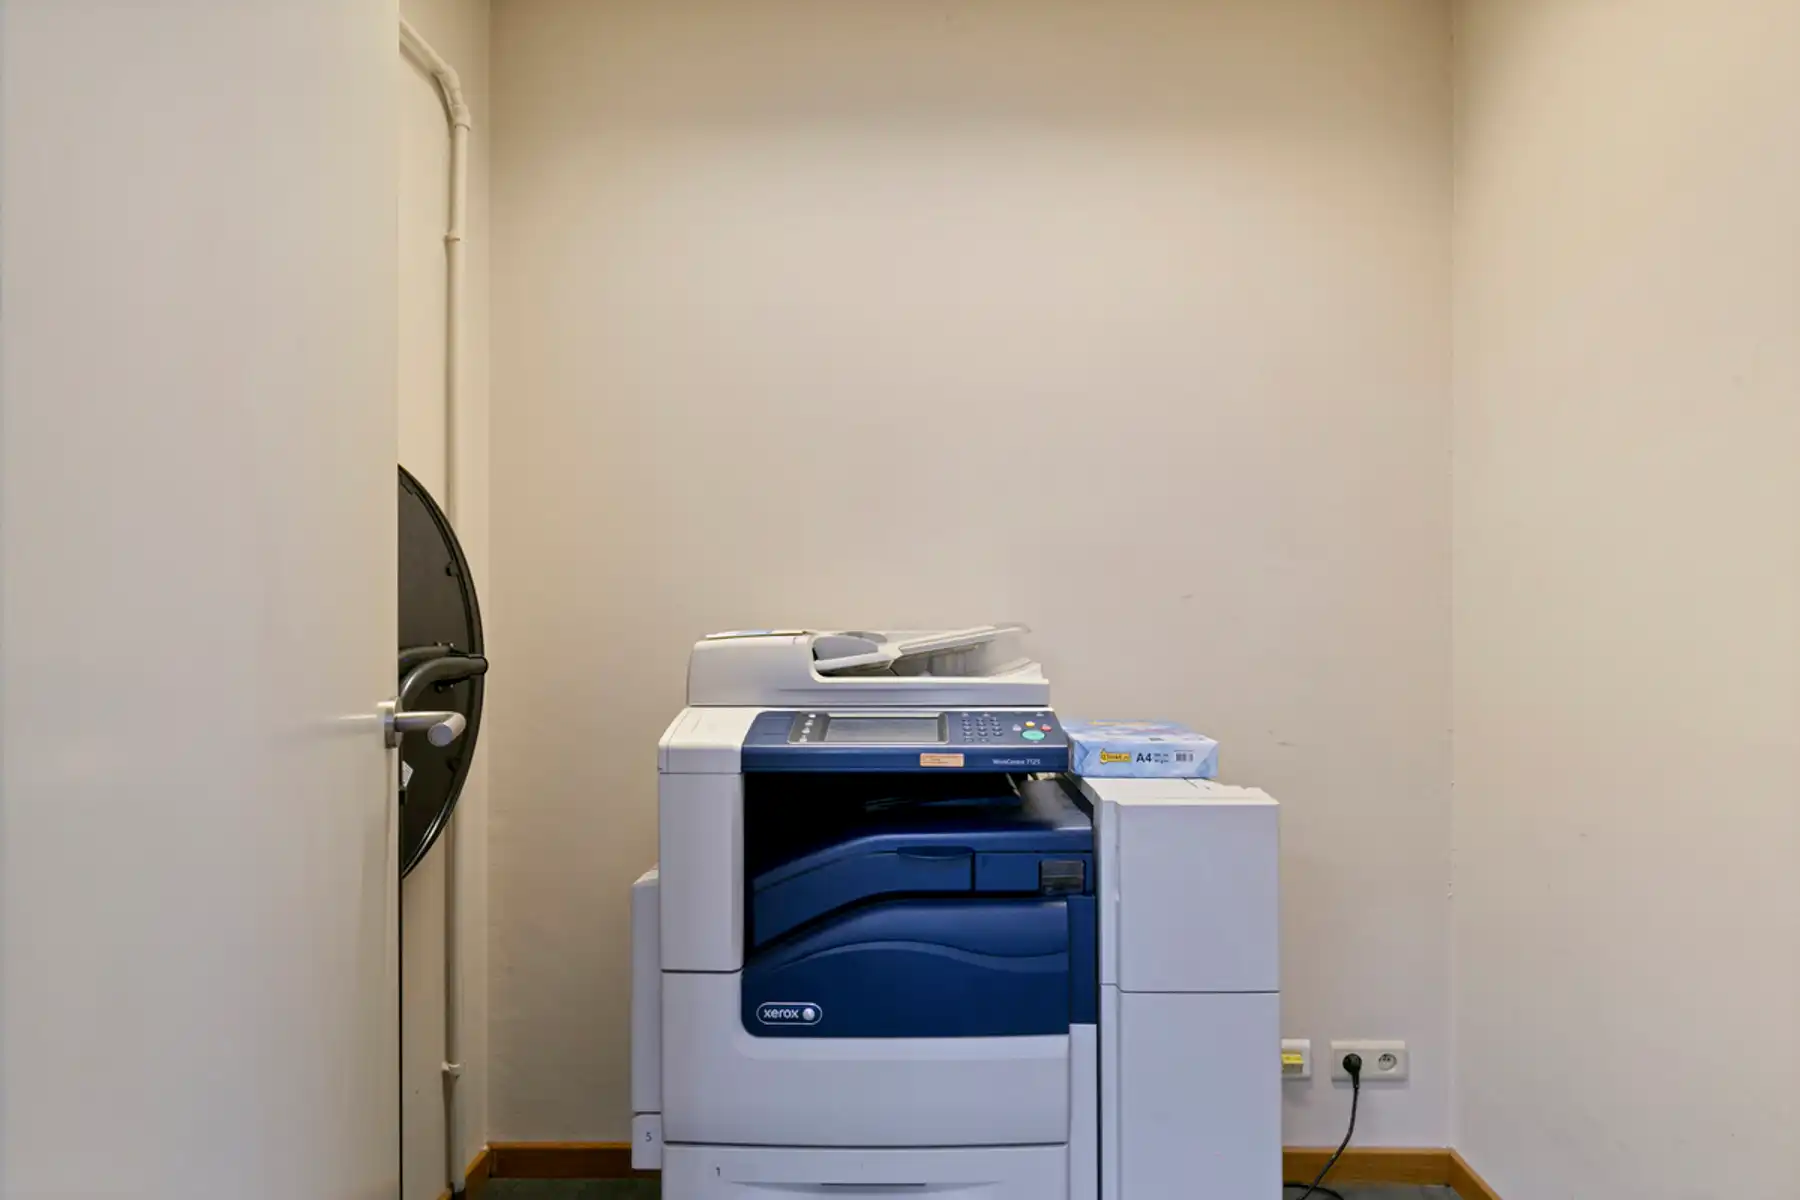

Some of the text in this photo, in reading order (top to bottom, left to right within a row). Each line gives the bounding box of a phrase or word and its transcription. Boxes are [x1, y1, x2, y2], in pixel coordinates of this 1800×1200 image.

[1136, 752, 1152, 763] A4
[763, 1008, 799, 1019] xerox
[645, 1131, 653, 1142] 5
[715, 1166, 721, 1177] 1
